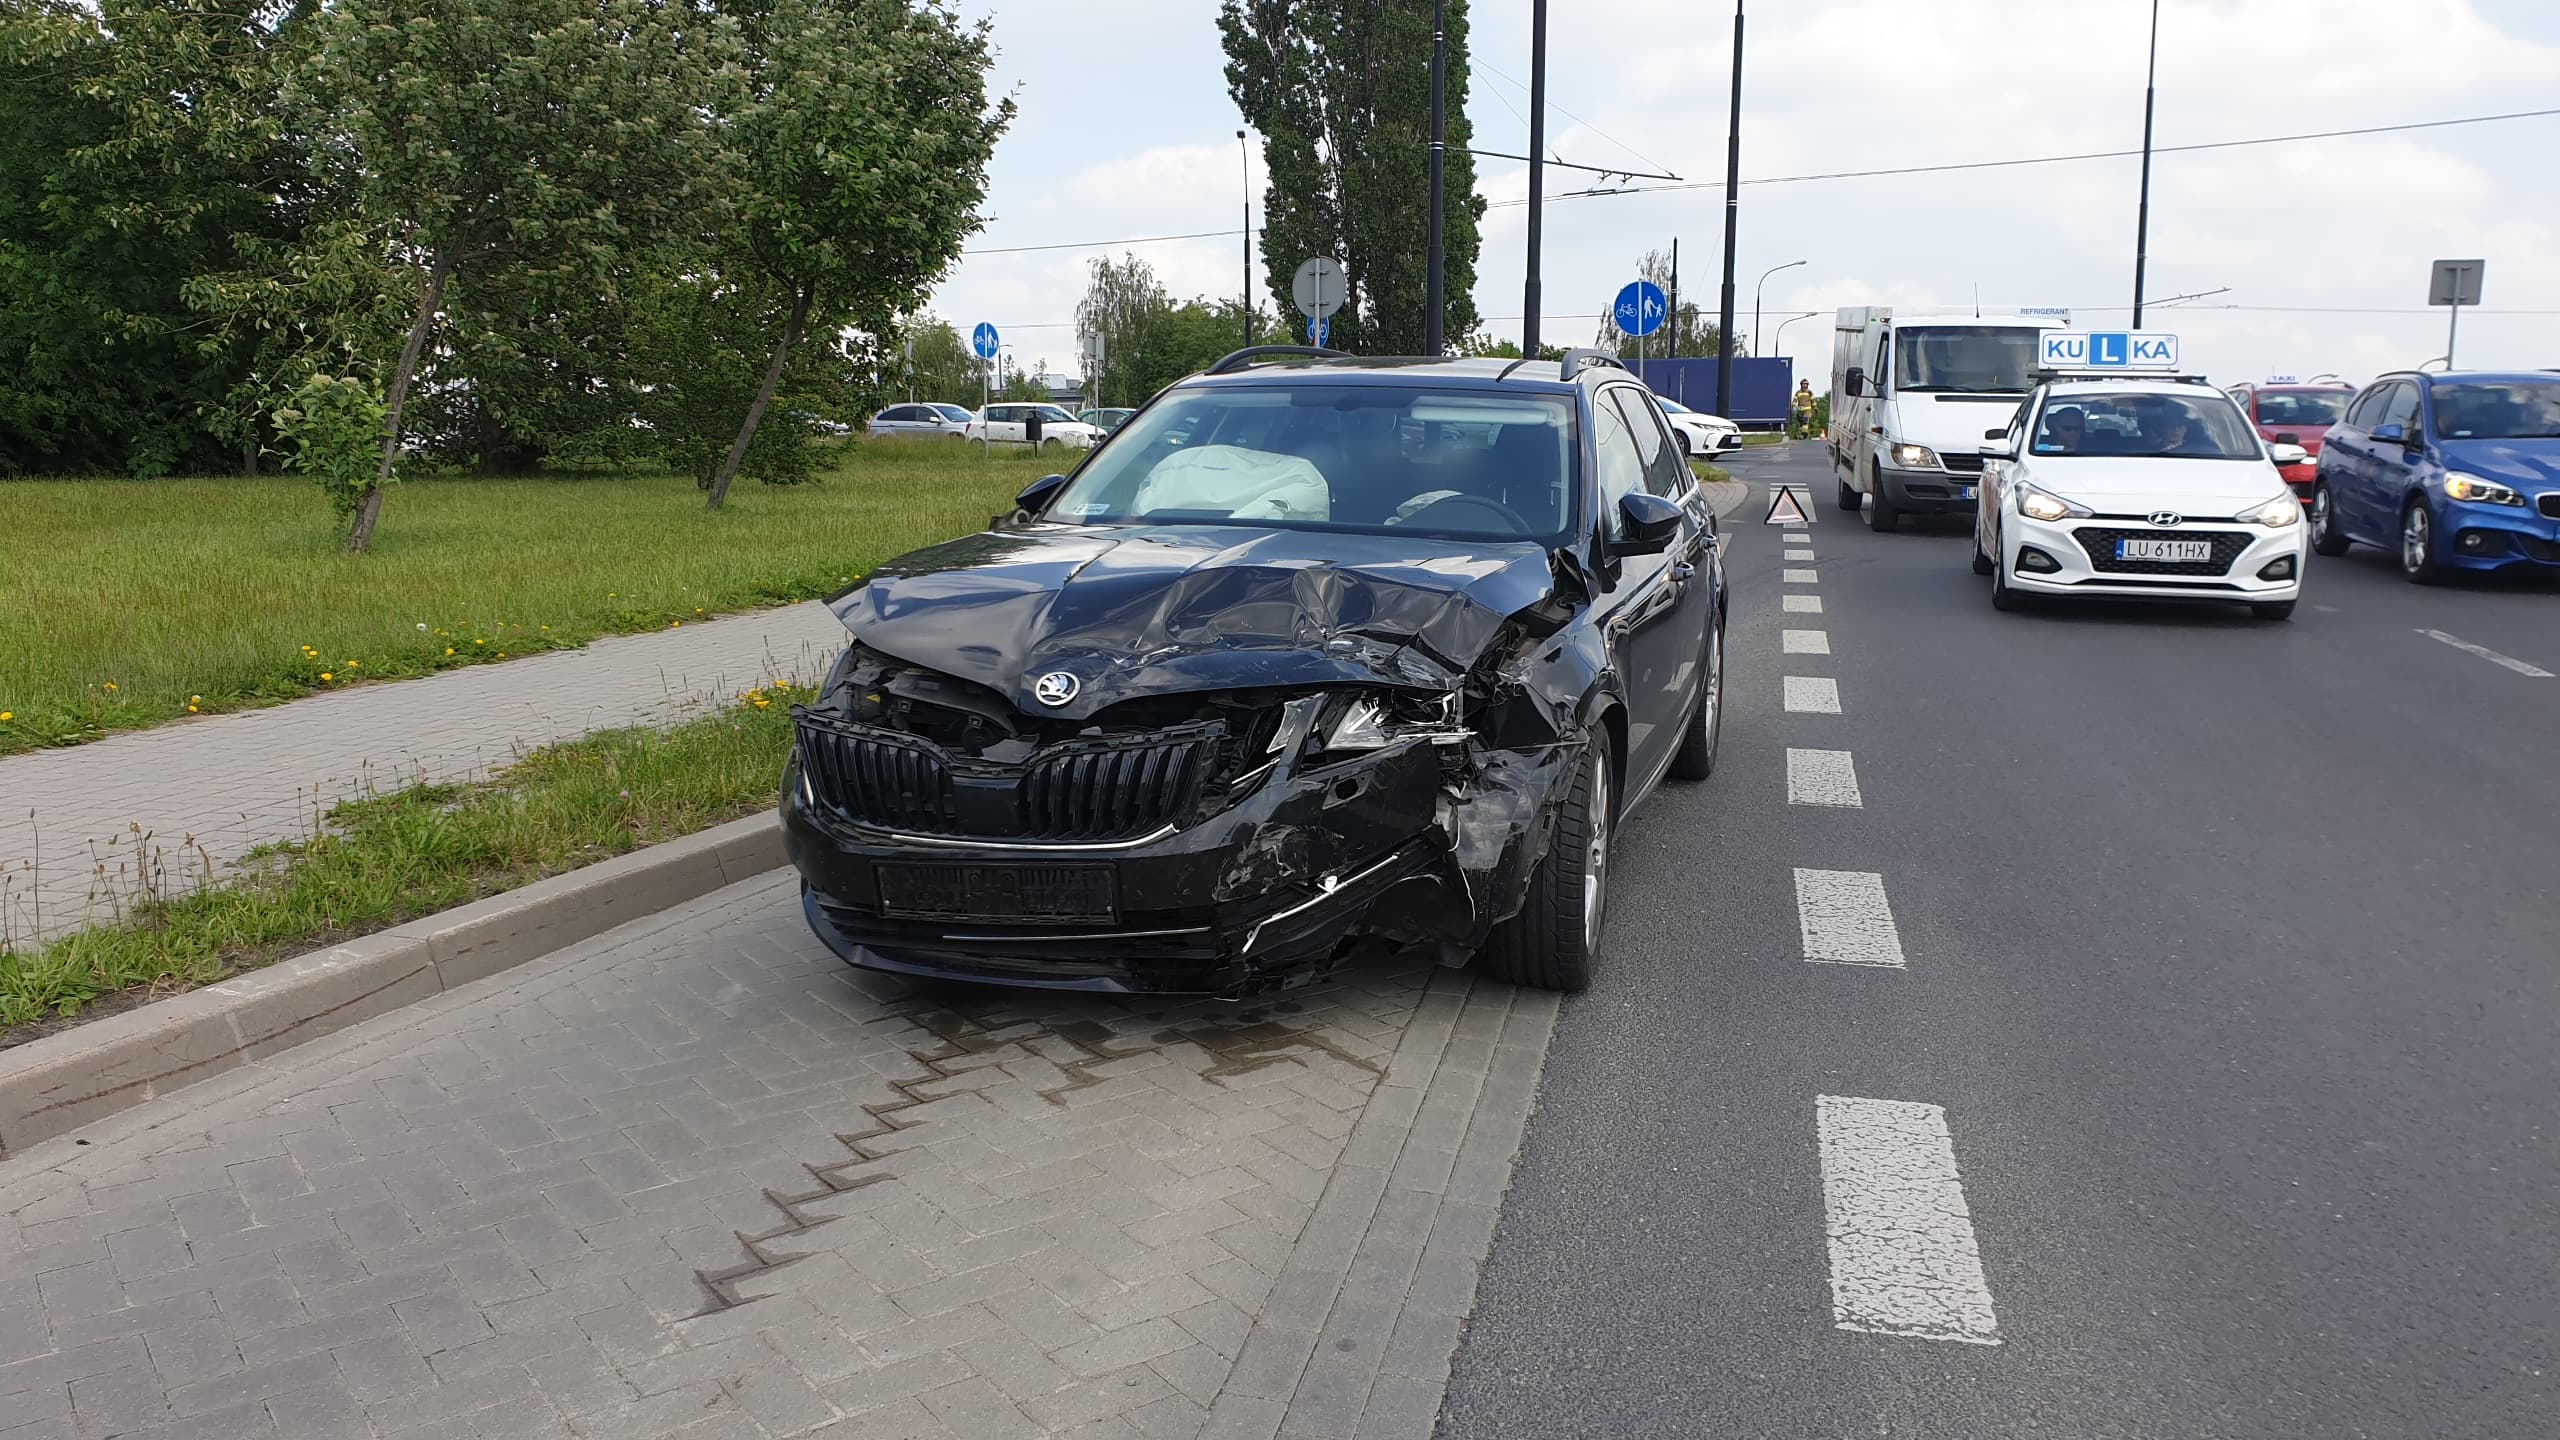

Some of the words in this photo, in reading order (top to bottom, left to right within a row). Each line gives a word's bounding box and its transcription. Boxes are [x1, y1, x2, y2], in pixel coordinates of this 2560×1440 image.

[2020, 307, 2069, 315] REFRIGERANT
[2127, 541, 2149, 557] LU
[2154, 542, 2207, 558] 611HX
